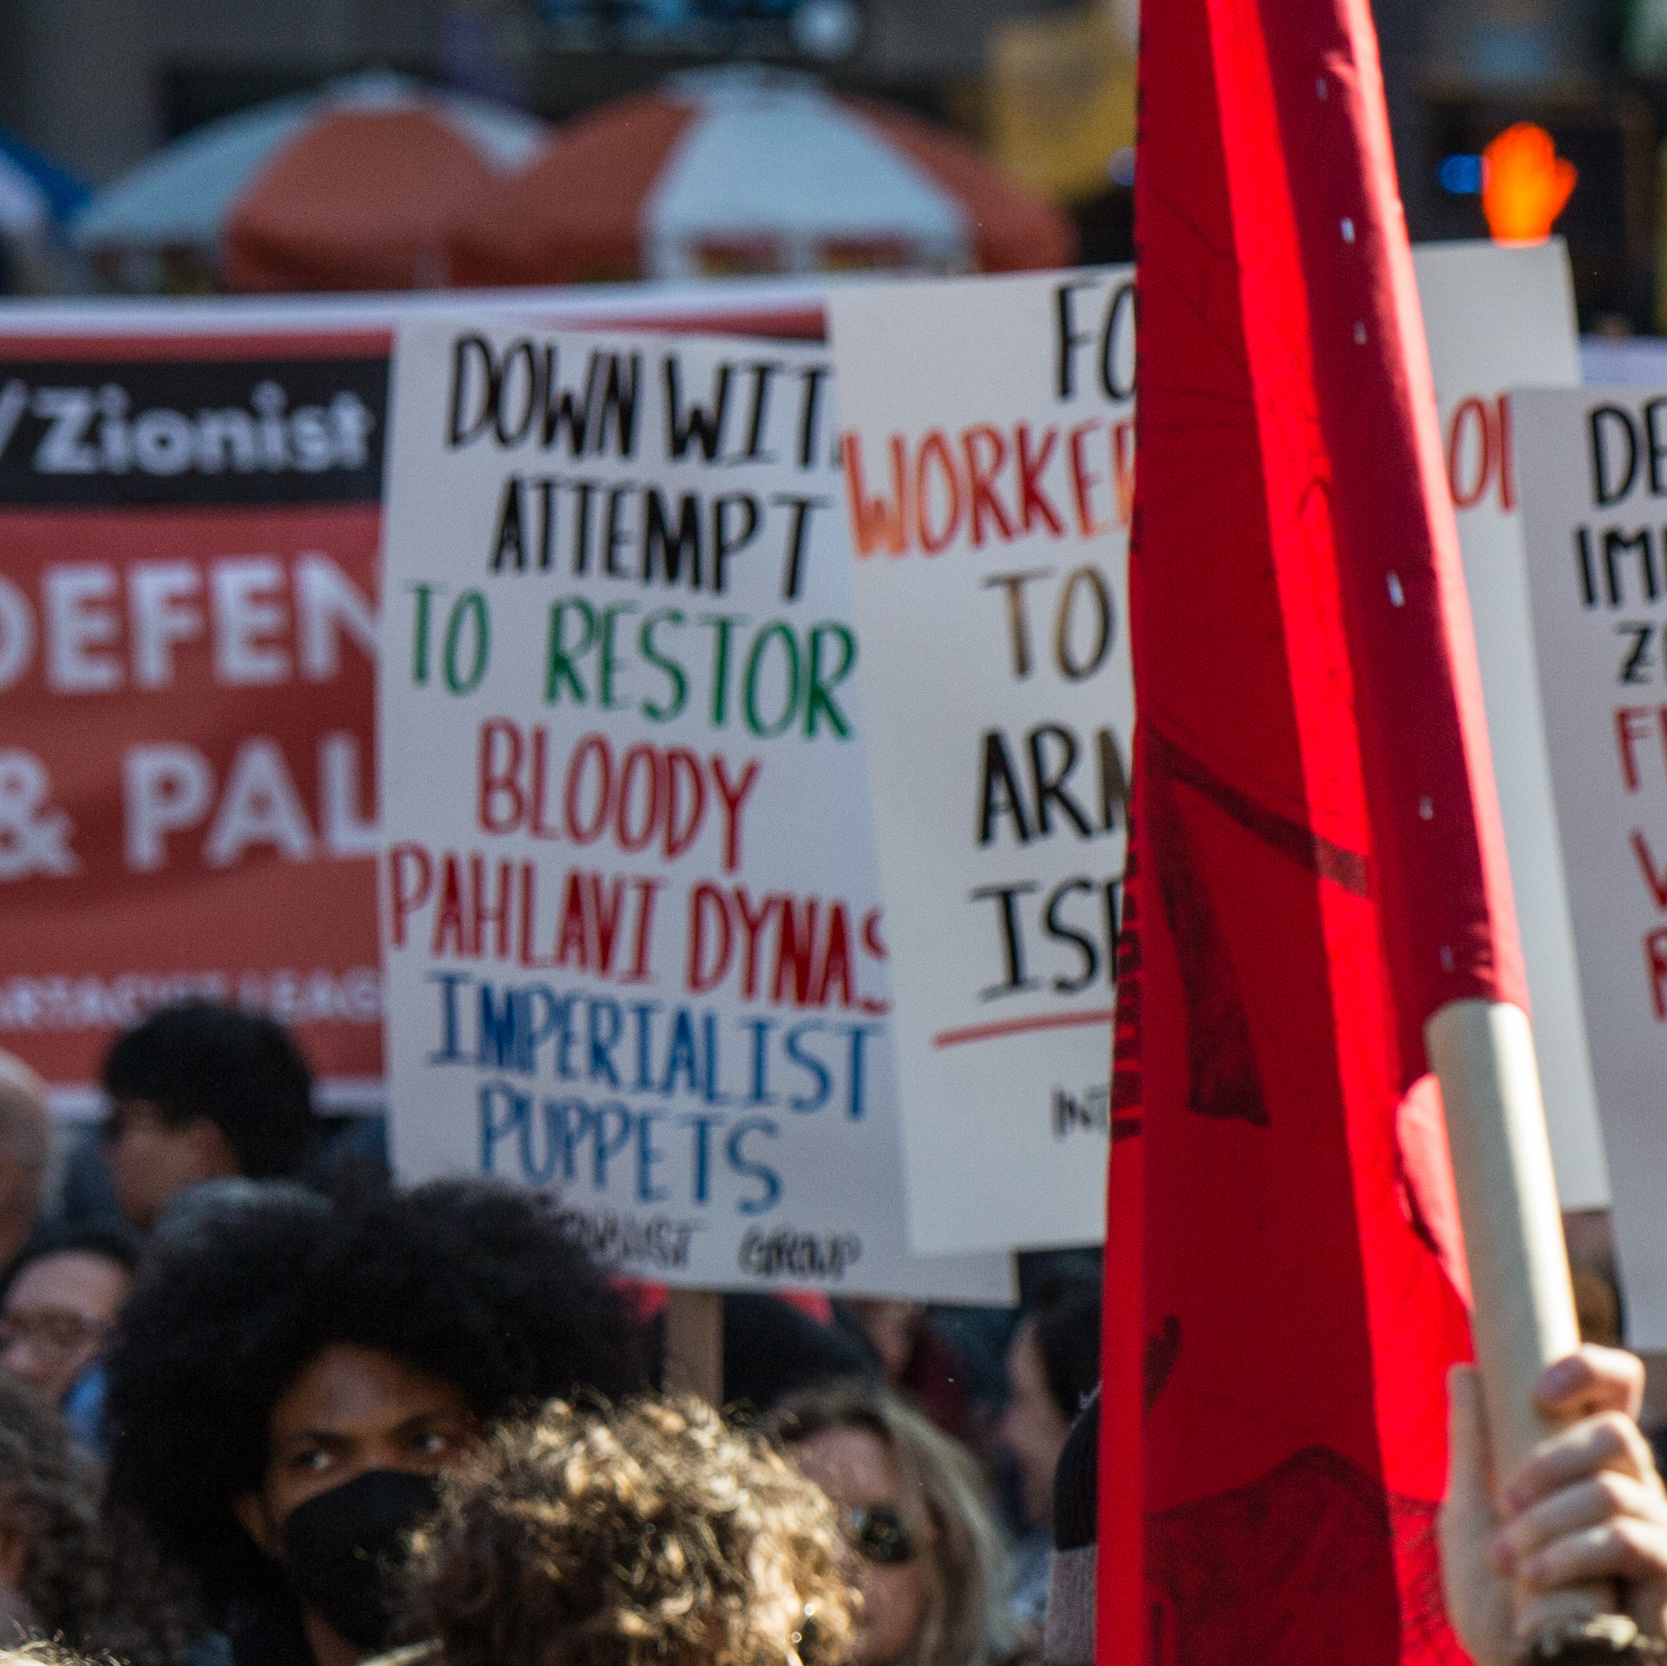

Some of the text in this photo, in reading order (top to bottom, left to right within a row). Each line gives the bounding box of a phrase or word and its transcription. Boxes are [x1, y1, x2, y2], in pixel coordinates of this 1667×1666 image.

[447, 333, 843, 470] DOWN WIT
[488, 471, 833, 602] ATTEMPT
[404, 581, 490, 697] TO
[981, 560, 1119, 684] TO
[475, 716, 764, 875] BLOODY
[388, 842, 667, 988] PAHLAVI
[425, 970, 887, 1121] IMPERIALIST
[477, 1082, 785, 1216] PUPPETS
